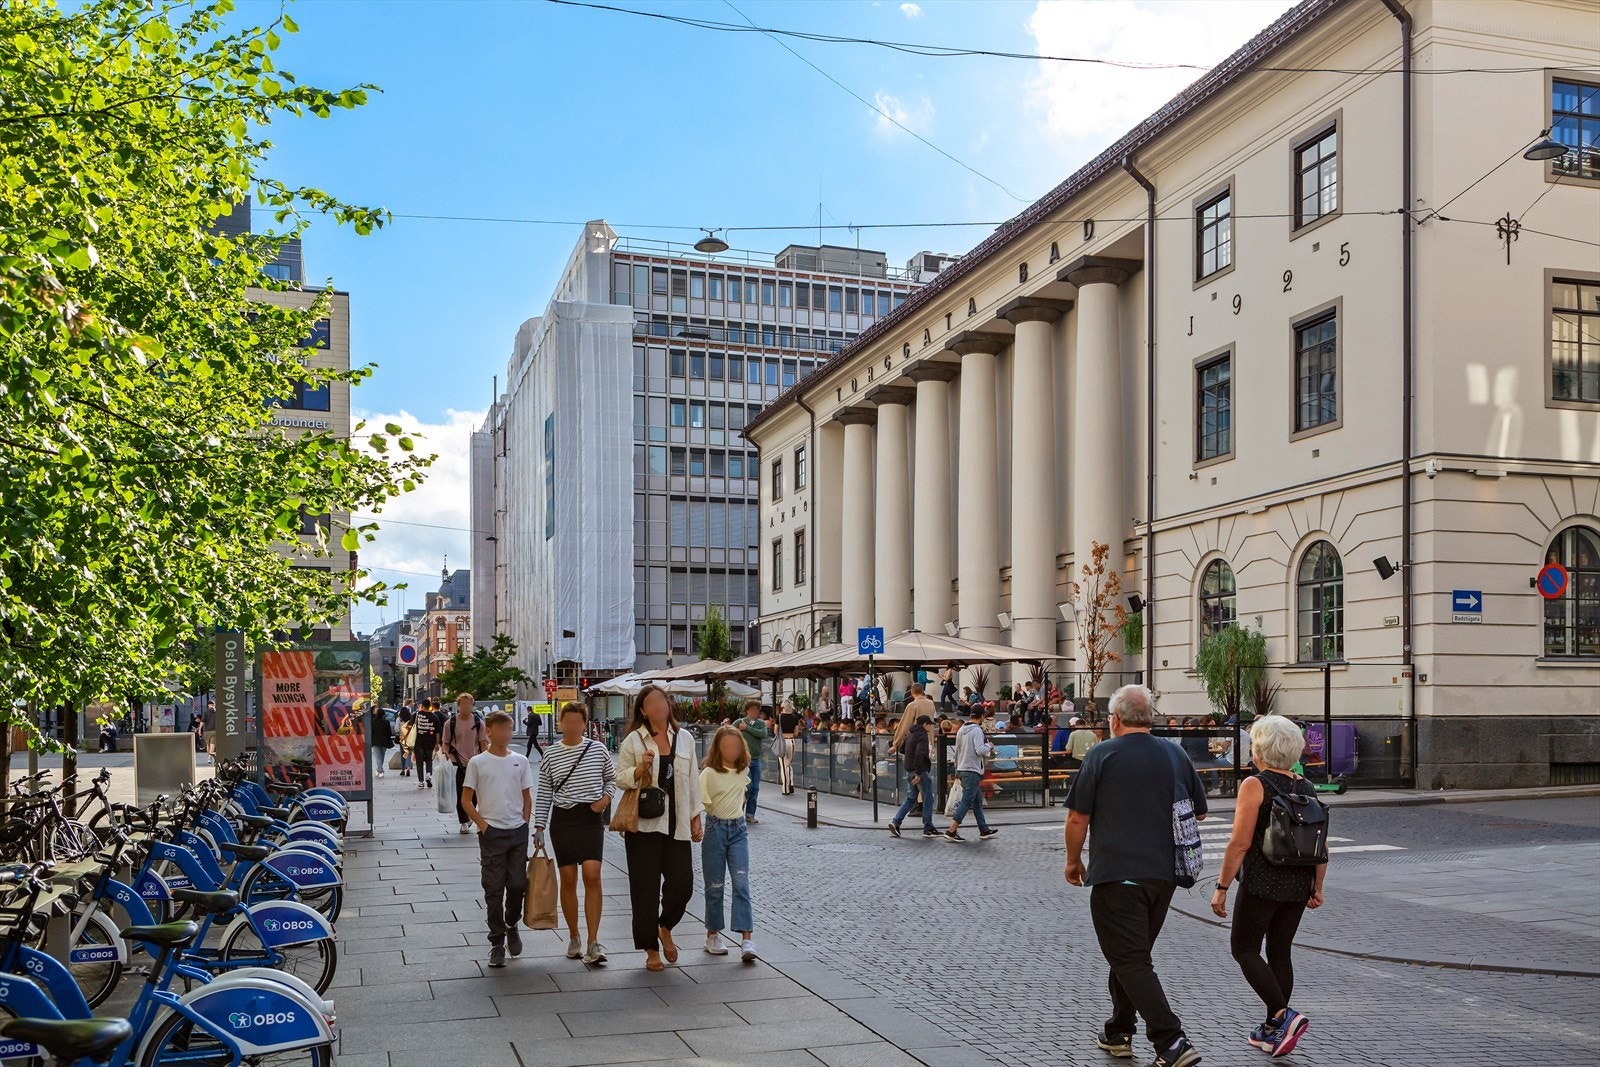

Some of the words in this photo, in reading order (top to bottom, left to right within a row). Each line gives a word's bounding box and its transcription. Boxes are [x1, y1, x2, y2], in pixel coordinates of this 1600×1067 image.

[835, 297, 977, 402] TORGGATA
[1019, 218, 1095, 283] BAD
[401, 635, 415, 643] Sone
[225, 640, 238, 671] Oslo
[276, 683, 301, 693] MORE
[272, 693, 307, 704] MUNCH
[222, 676, 239, 736] Bysykkel
[301, 867, 324, 875] OBOS
[282, 920, 313, 930] OBOS
[90, 951, 113, 959] OBOS
[254, 1011, 295, 1026] OBOS
[0, 1042, 31, 1054] OBOS
